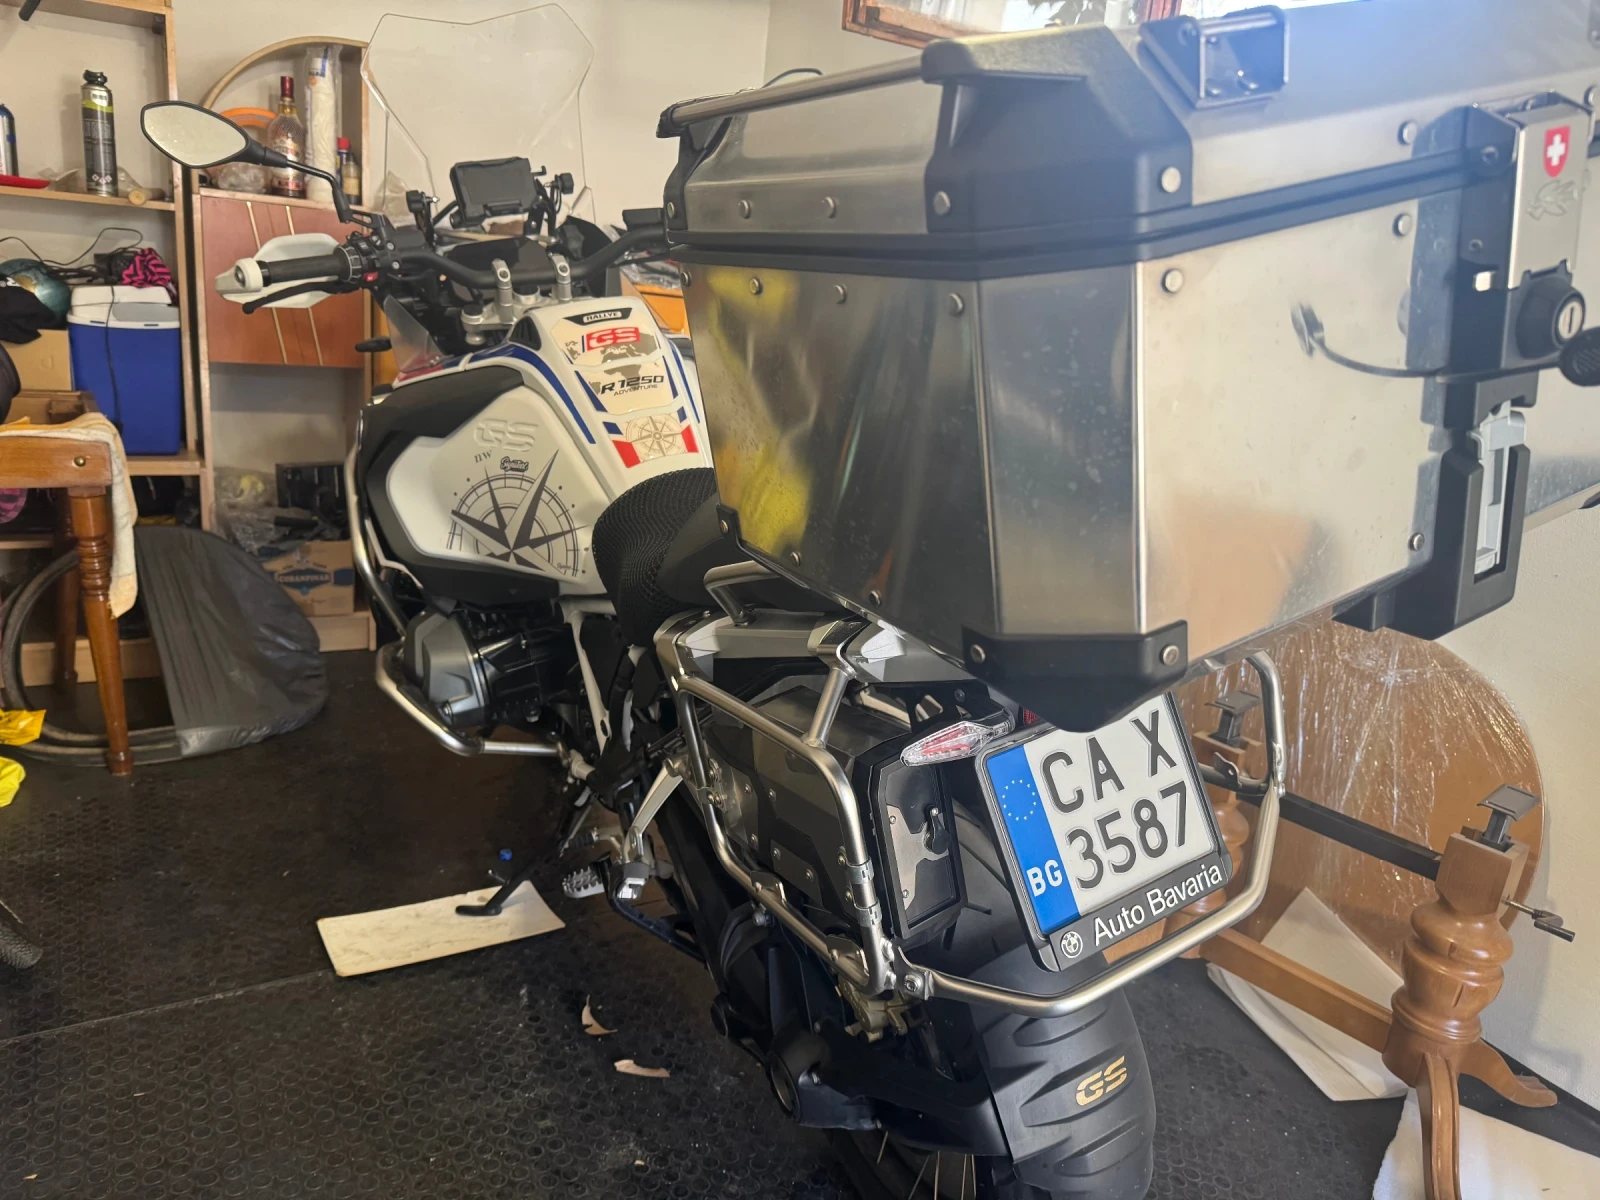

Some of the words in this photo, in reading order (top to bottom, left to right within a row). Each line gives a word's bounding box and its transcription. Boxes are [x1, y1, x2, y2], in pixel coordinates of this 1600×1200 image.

[586, 311, 619, 321] RALLYE
[589, 327, 638, 350] GS
[601, 382, 616, 394] R
[618, 375, 665, 387] 1250
[613, 384, 658, 397] ADVENTURE
[473, 418, 538, 452] GS
[1041, 736, 1124, 814] CA
[1131, 709, 1177, 777] X
[1067, 780, 1187, 889] 3587
[1027, 859, 1063, 897] BG
[1094, 908, 1145, 946] Auto
[1146, 863, 1222, 916] Bavaria
[1075, 1055, 1128, 1106] GS
